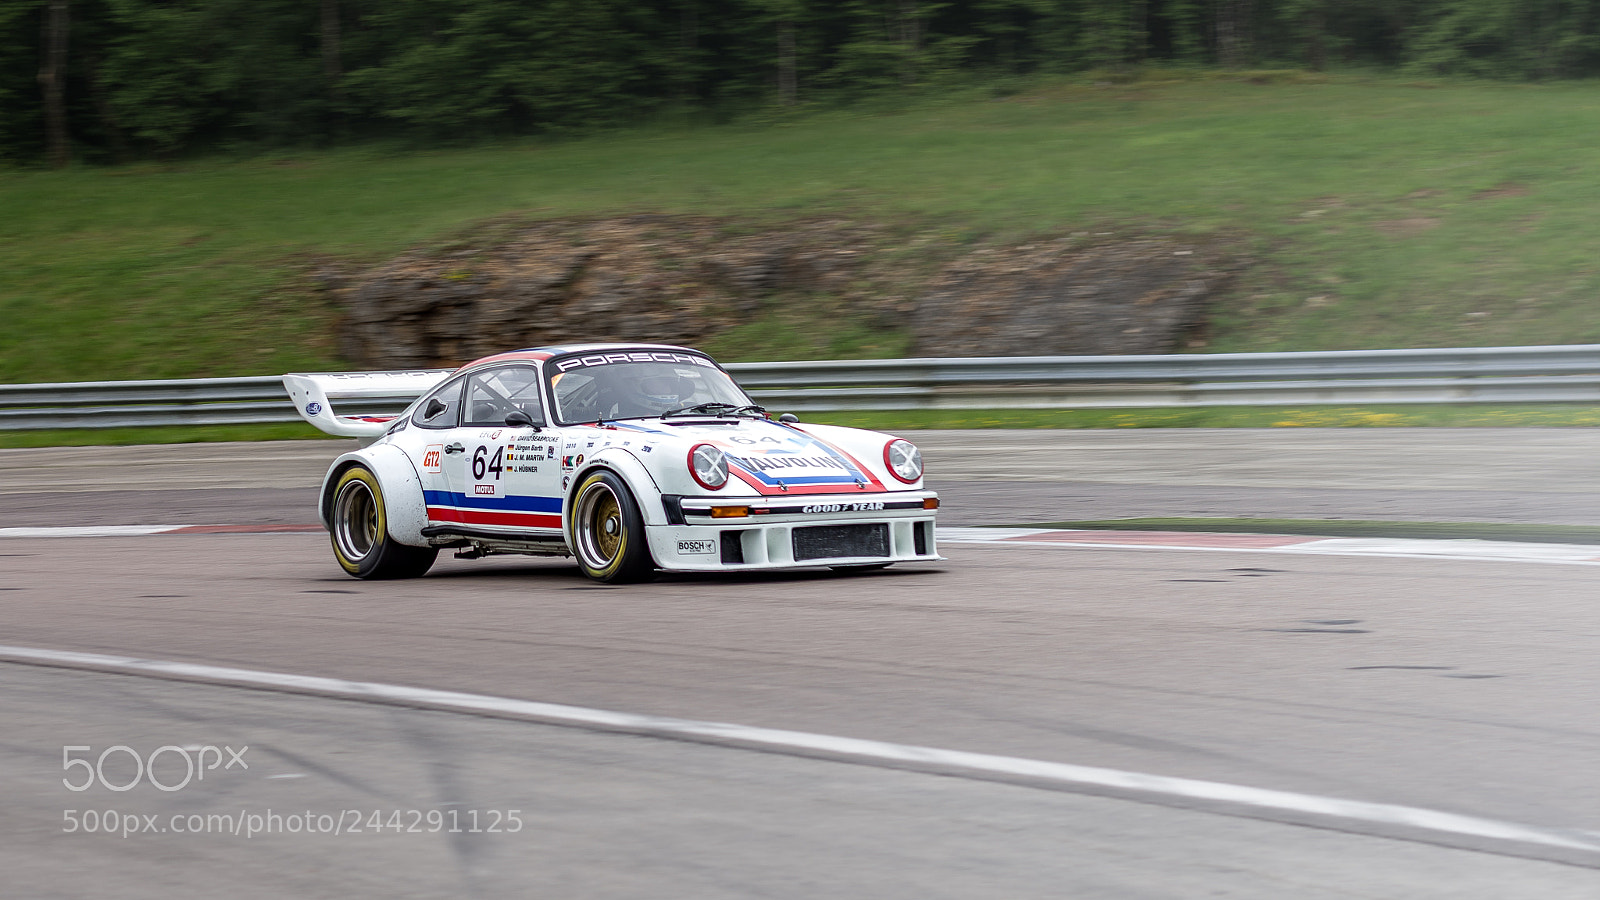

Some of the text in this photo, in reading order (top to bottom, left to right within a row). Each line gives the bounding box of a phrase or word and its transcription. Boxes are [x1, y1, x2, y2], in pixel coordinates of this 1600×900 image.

[556, 352, 717, 372] PORSCHE
[423, 451, 440, 468] GT2
[472, 445, 504, 480] 64
[475, 486, 494, 494] MOTUL
